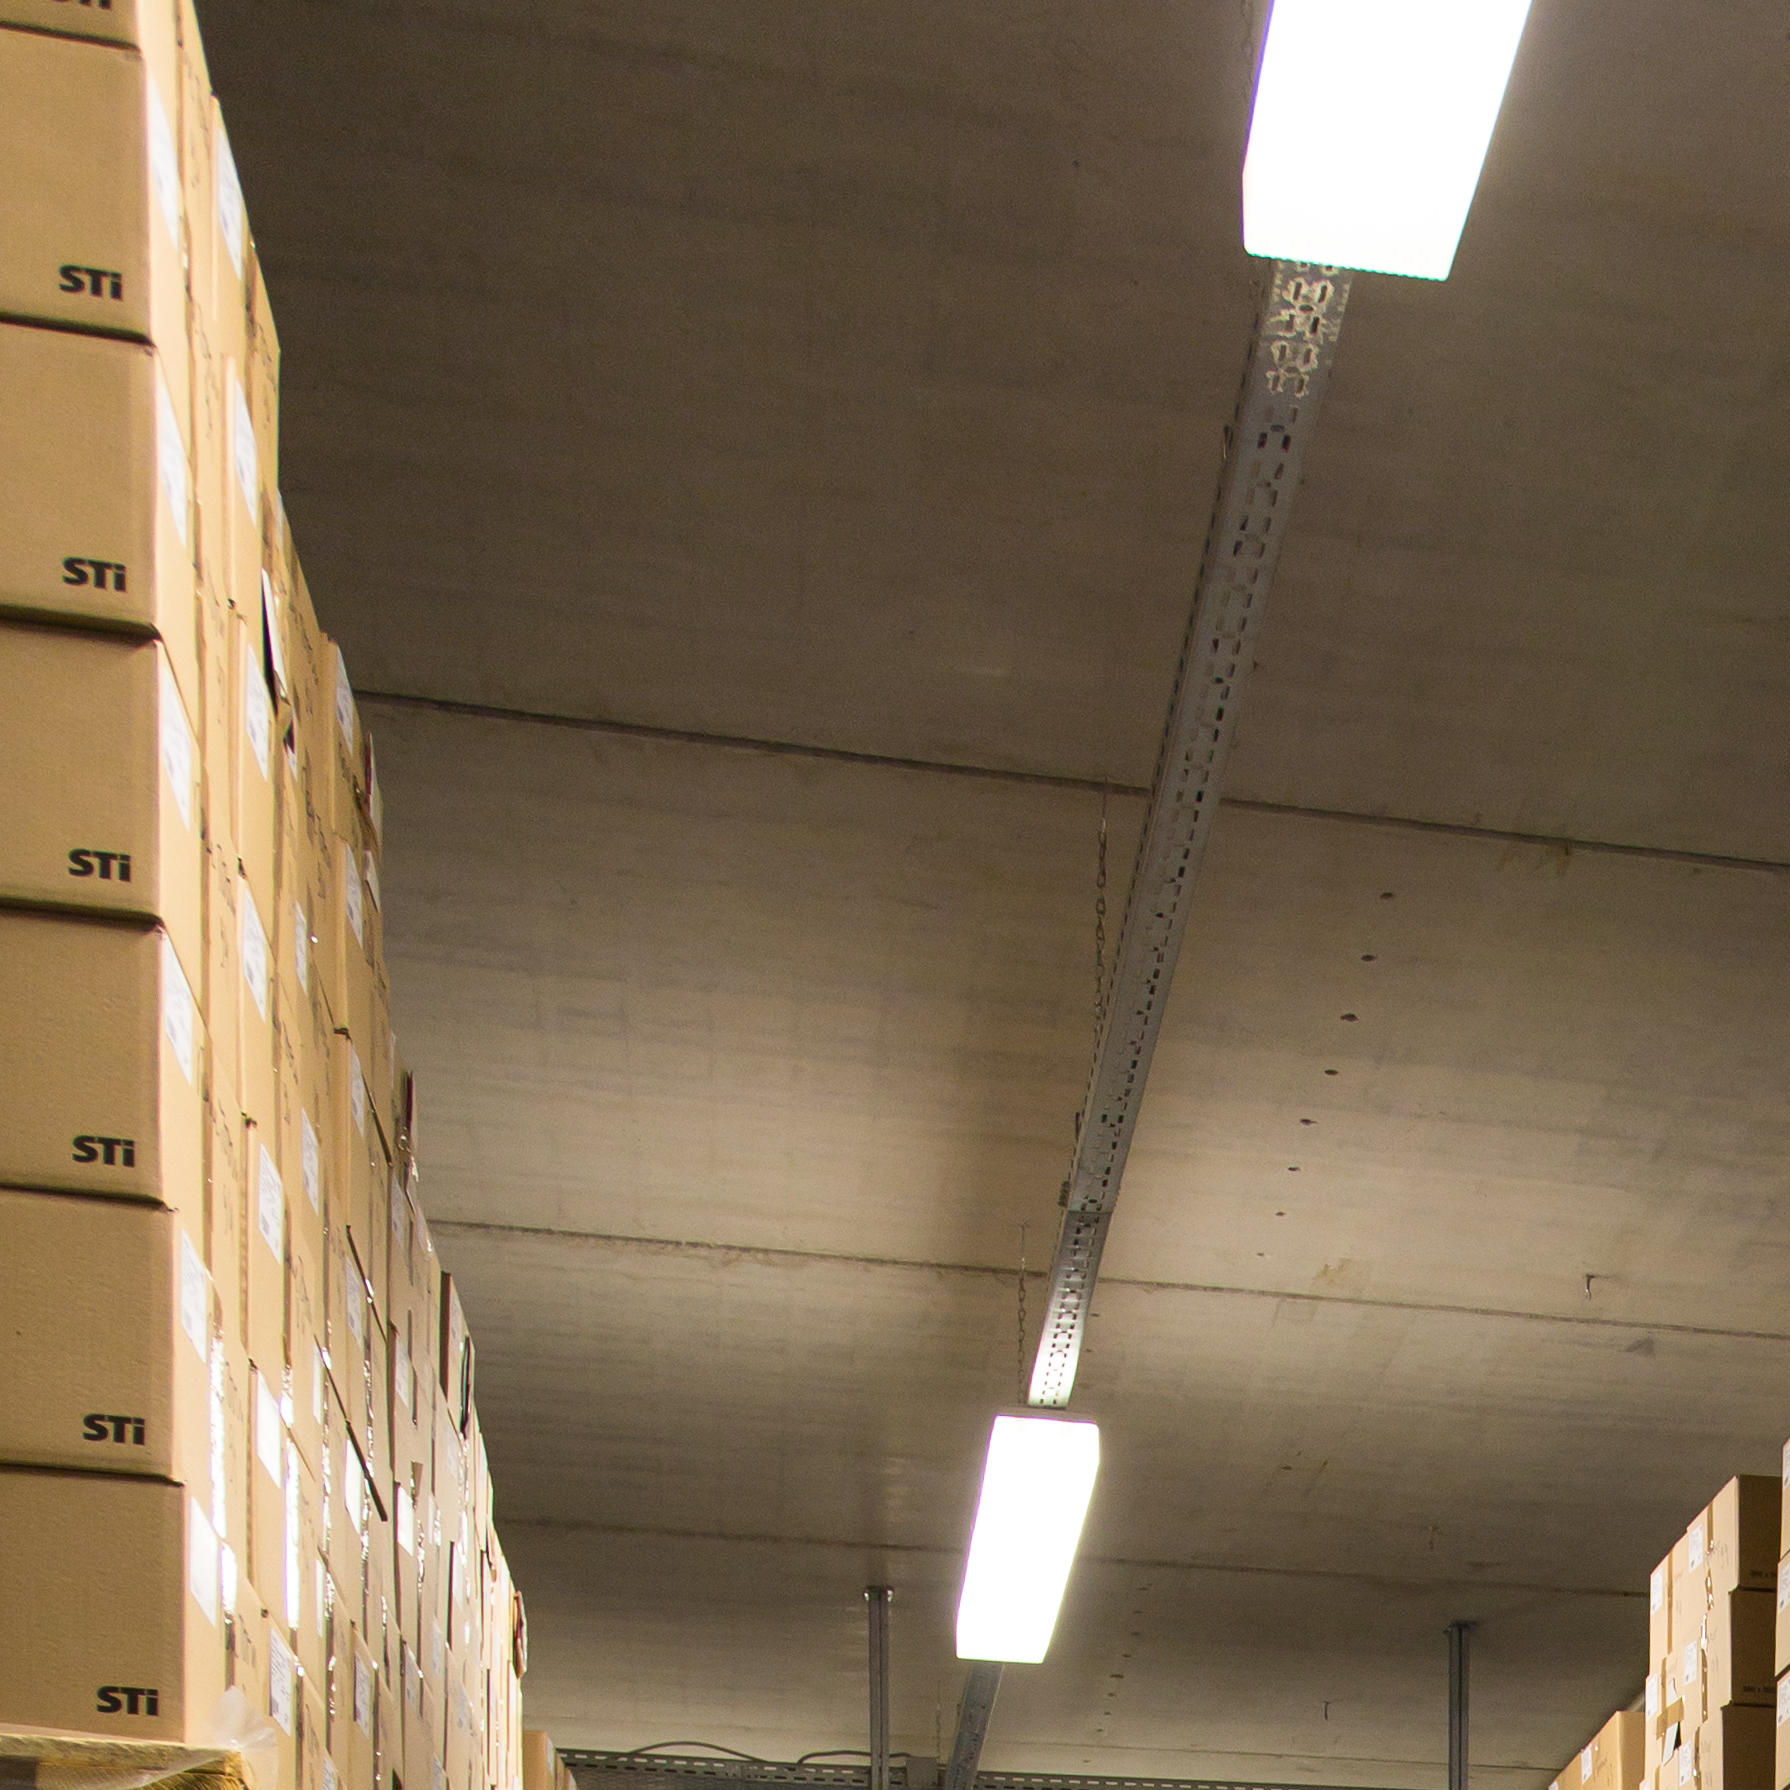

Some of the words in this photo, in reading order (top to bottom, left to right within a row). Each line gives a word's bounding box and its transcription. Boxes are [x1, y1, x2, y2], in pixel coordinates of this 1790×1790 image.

[58, 264, 124, 301] STi
[61, 557, 128, 593] STi
[67, 848, 132, 883] STi
[71, 1134, 136, 1168] STi
[82, 1413, 146, 1446] STi
[96, 1685, 160, 1716] STi
